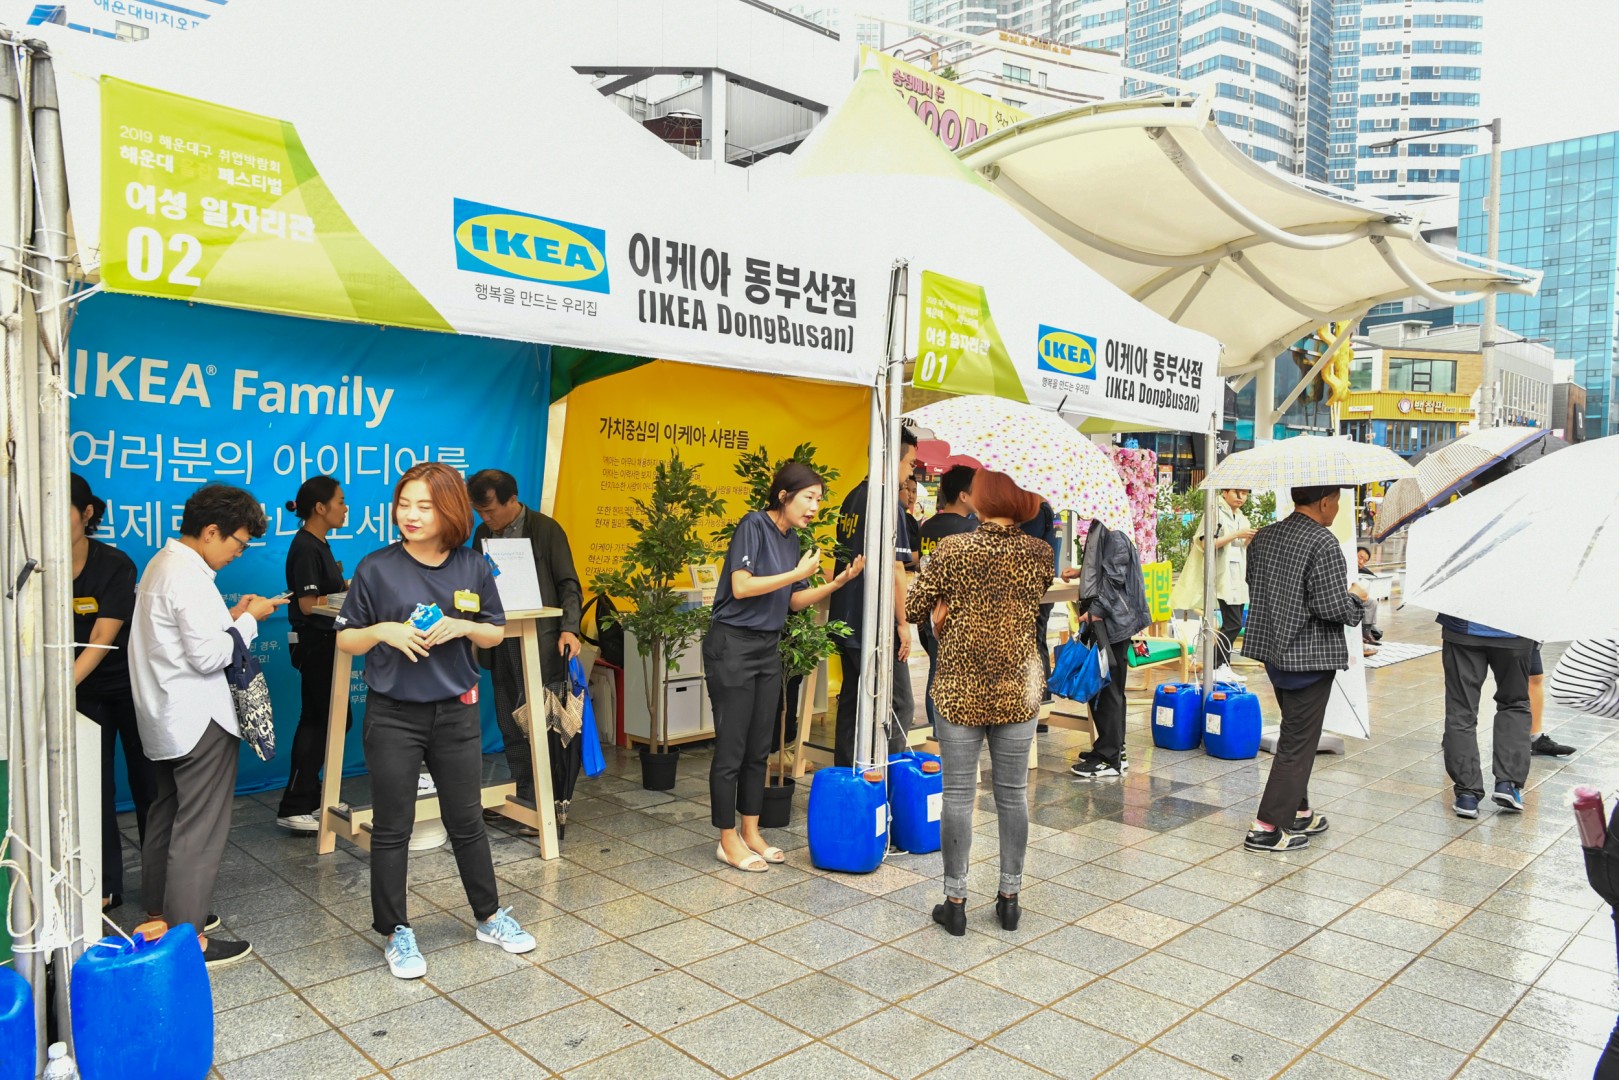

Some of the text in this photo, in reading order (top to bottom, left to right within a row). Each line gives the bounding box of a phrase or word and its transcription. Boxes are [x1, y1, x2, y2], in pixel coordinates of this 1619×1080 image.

[120, 125, 281, 174] 2019 해운대구 취업박람회
[120, 145, 174, 173] 해운대
[125, 181, 316, 243] 여성 일자리관
[127, 227, 202, 286] 02
[471, 223, 597, 271] IKEA
[628, 232, 857, 318] 이케아 동부산점
[475, 283, 597, 317] 행복을 만드는 우리집
[926, 327, 946, 347] 여성
[1044, 339, 1091, 366] IKEA
[921, 351, 948, 383] 01
[1105, 339, 1203, 390] 이케아 동부산점
[233, 369, 394, 429] Family
[600, 417, 750, 450] 가치중심의 이케아 사람들
[69, 430, 253, 485] 여러분의
[596, 505, 611, 516] 또한
[590, 543, 613, 553] 이케아
